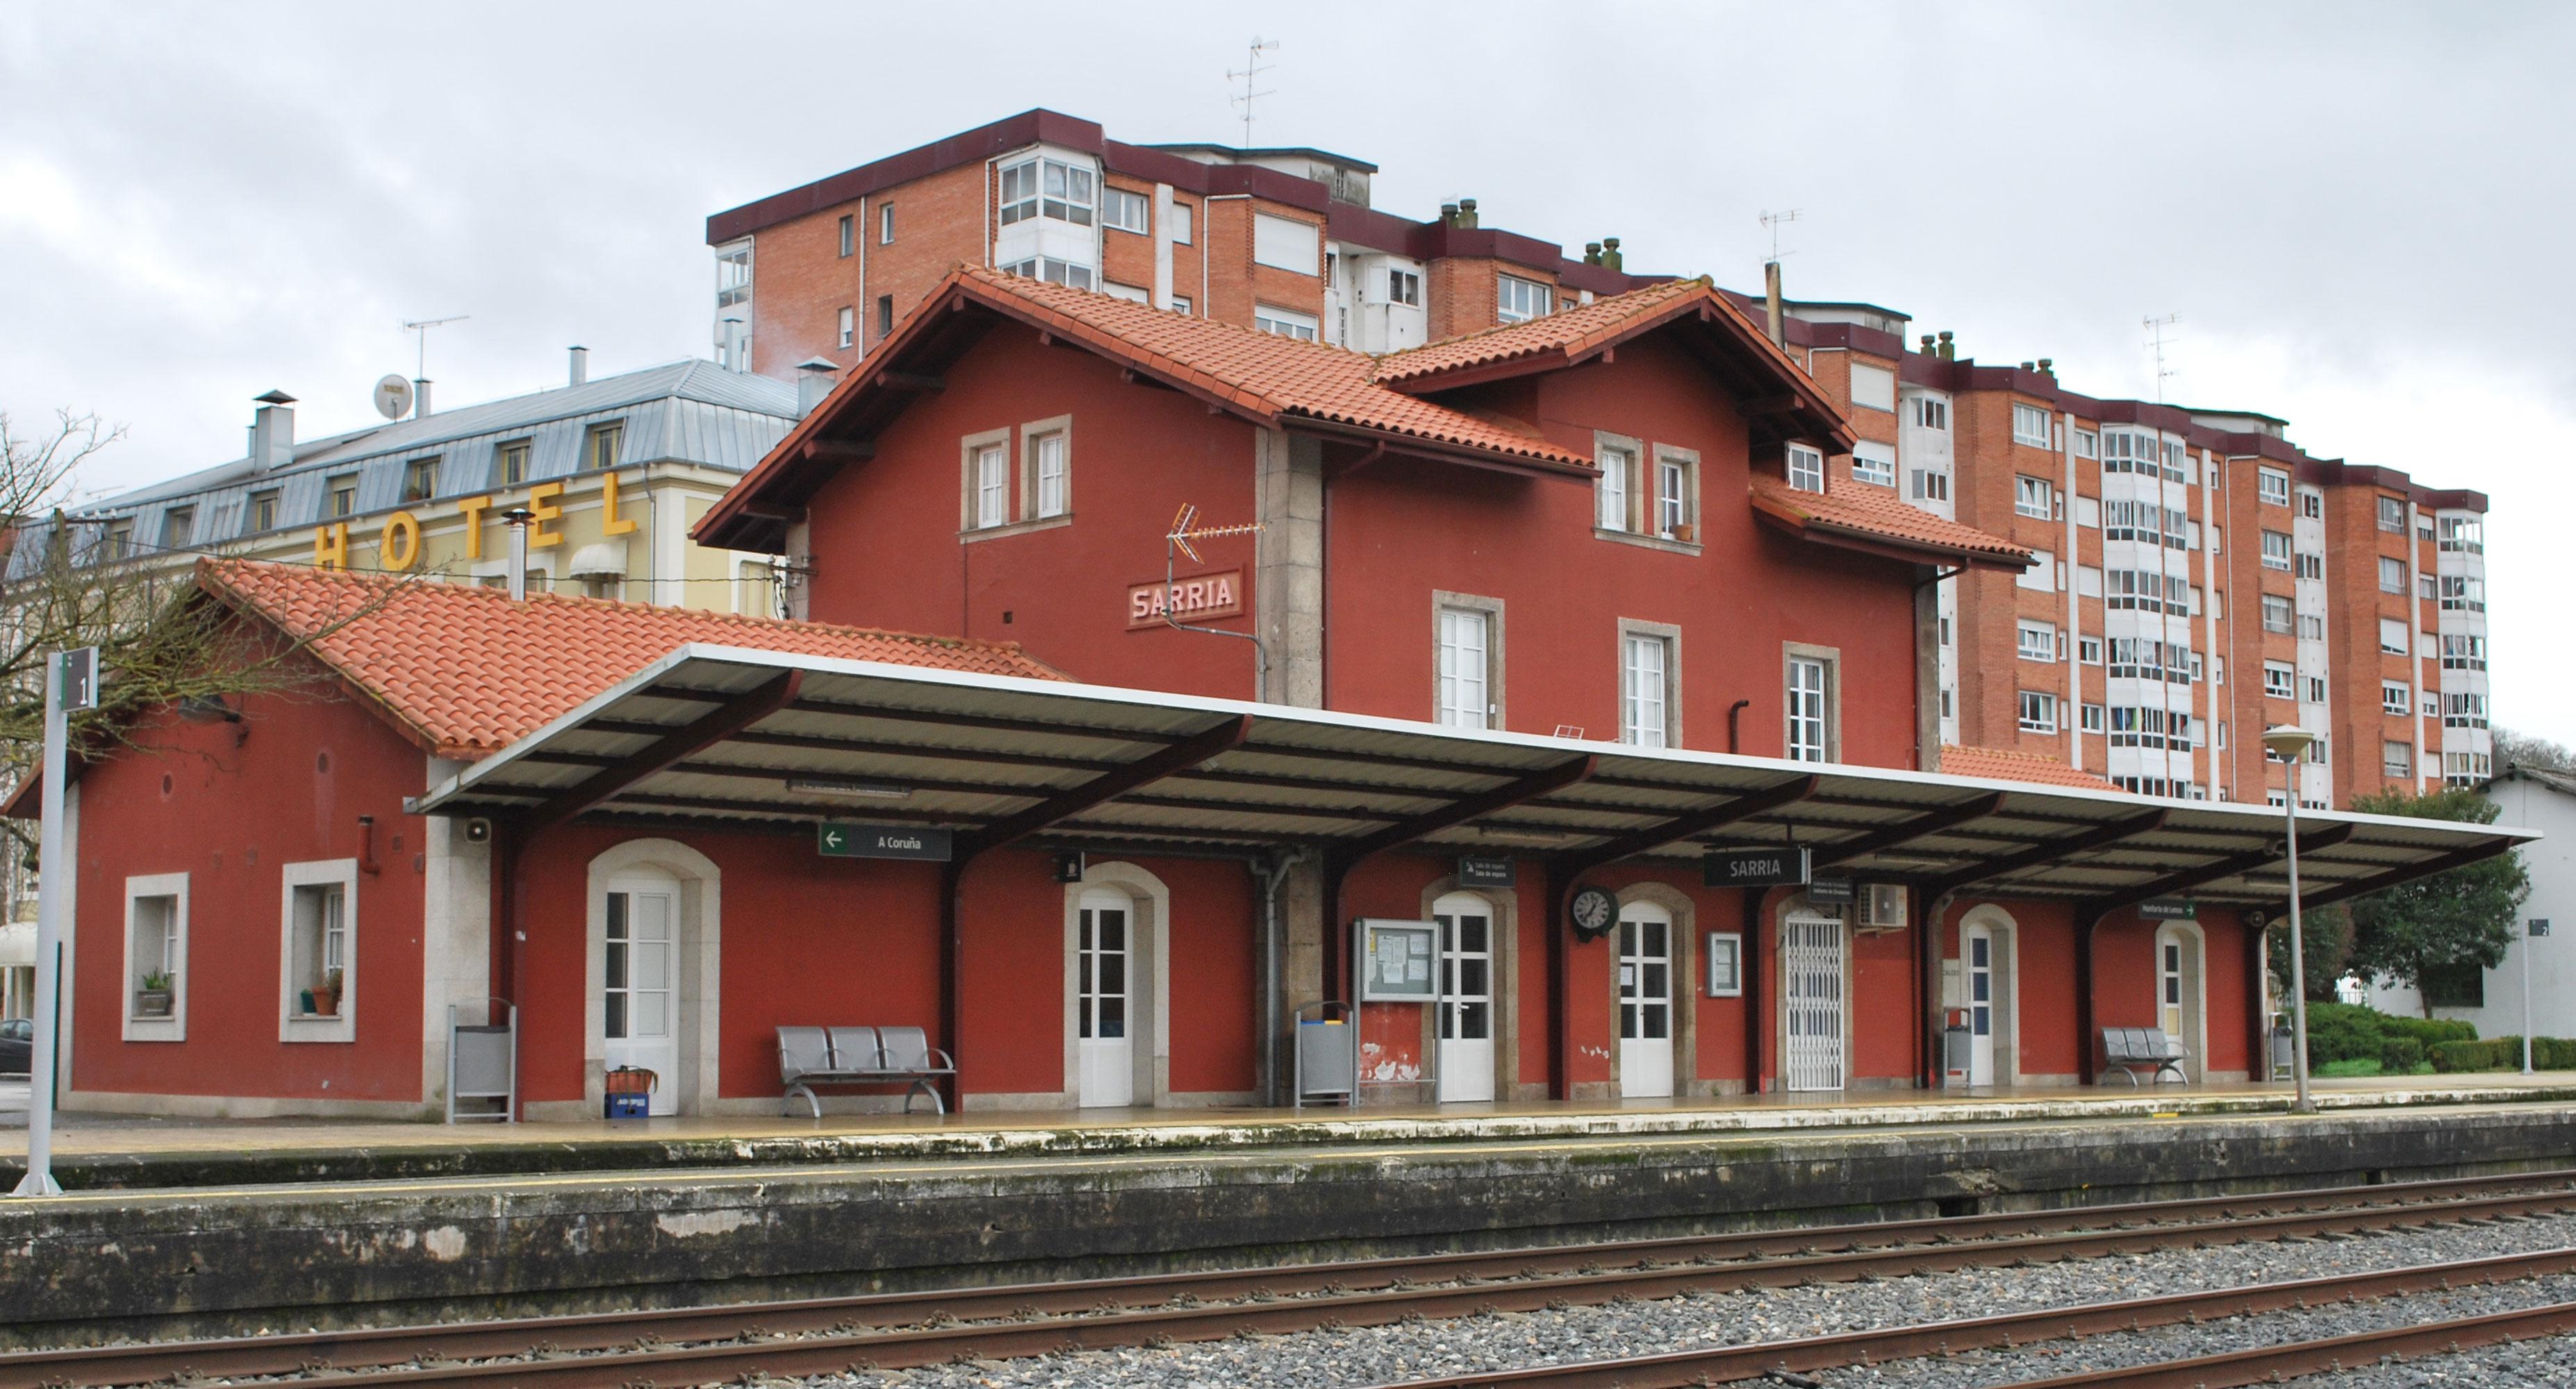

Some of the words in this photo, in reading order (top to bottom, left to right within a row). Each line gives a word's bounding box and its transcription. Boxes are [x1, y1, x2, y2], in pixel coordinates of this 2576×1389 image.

[315, 472, 636, 572] HOTEL
[1133, 579, 1234, 617] SARRIA
[80, 677, 88, 705] 1
[878, 836, 886, 848] A
[887, 836, 921, 849] Coruña
[1730, 859, 1781, 877] SARRIA
[2543, 926, 2548, 935] 2
